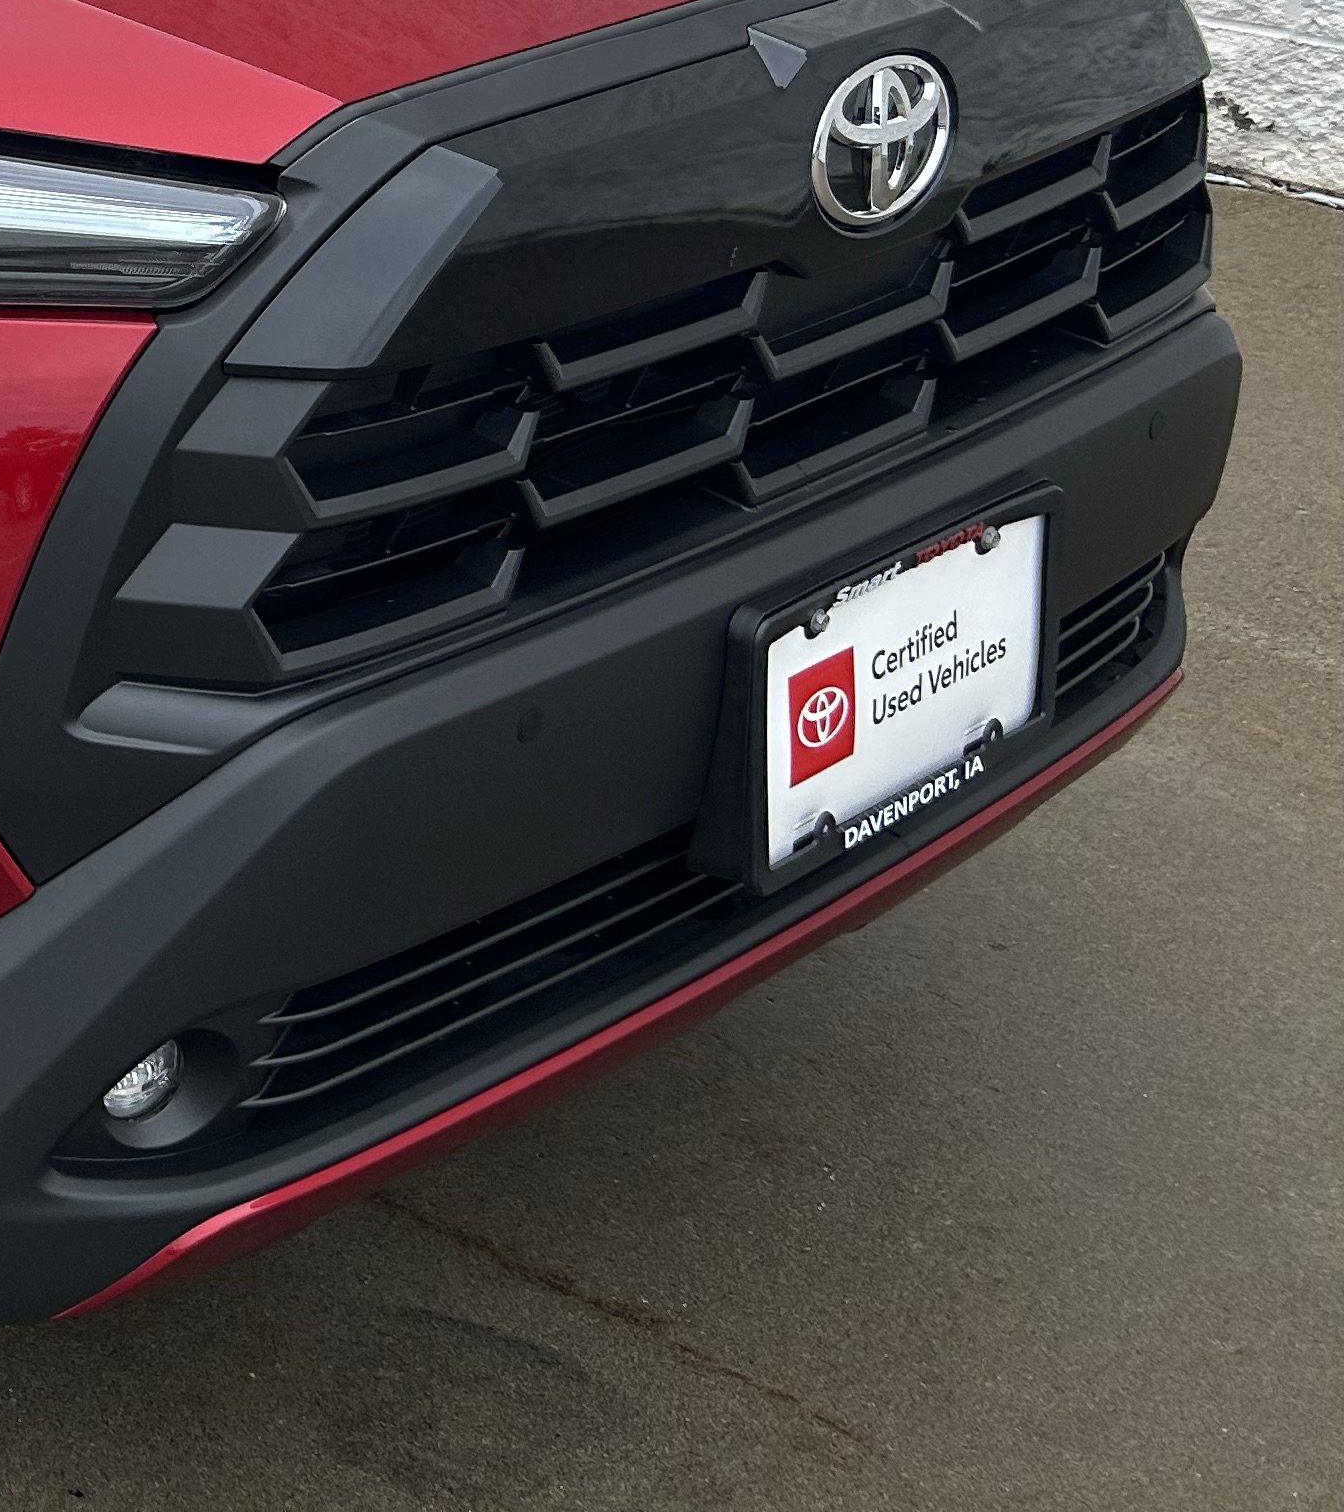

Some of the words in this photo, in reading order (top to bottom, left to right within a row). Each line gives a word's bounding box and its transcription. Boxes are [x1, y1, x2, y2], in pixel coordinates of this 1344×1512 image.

[835, 561, 902, 604] Smart
[870, 609, 959, 680] Certified
[871, 676, 923, 725] Used
[927, 637, 1007, 695] Vehicles
[843, 766, 961, 849] DAVENPORT,
[964, 755, 985, 780] IA
